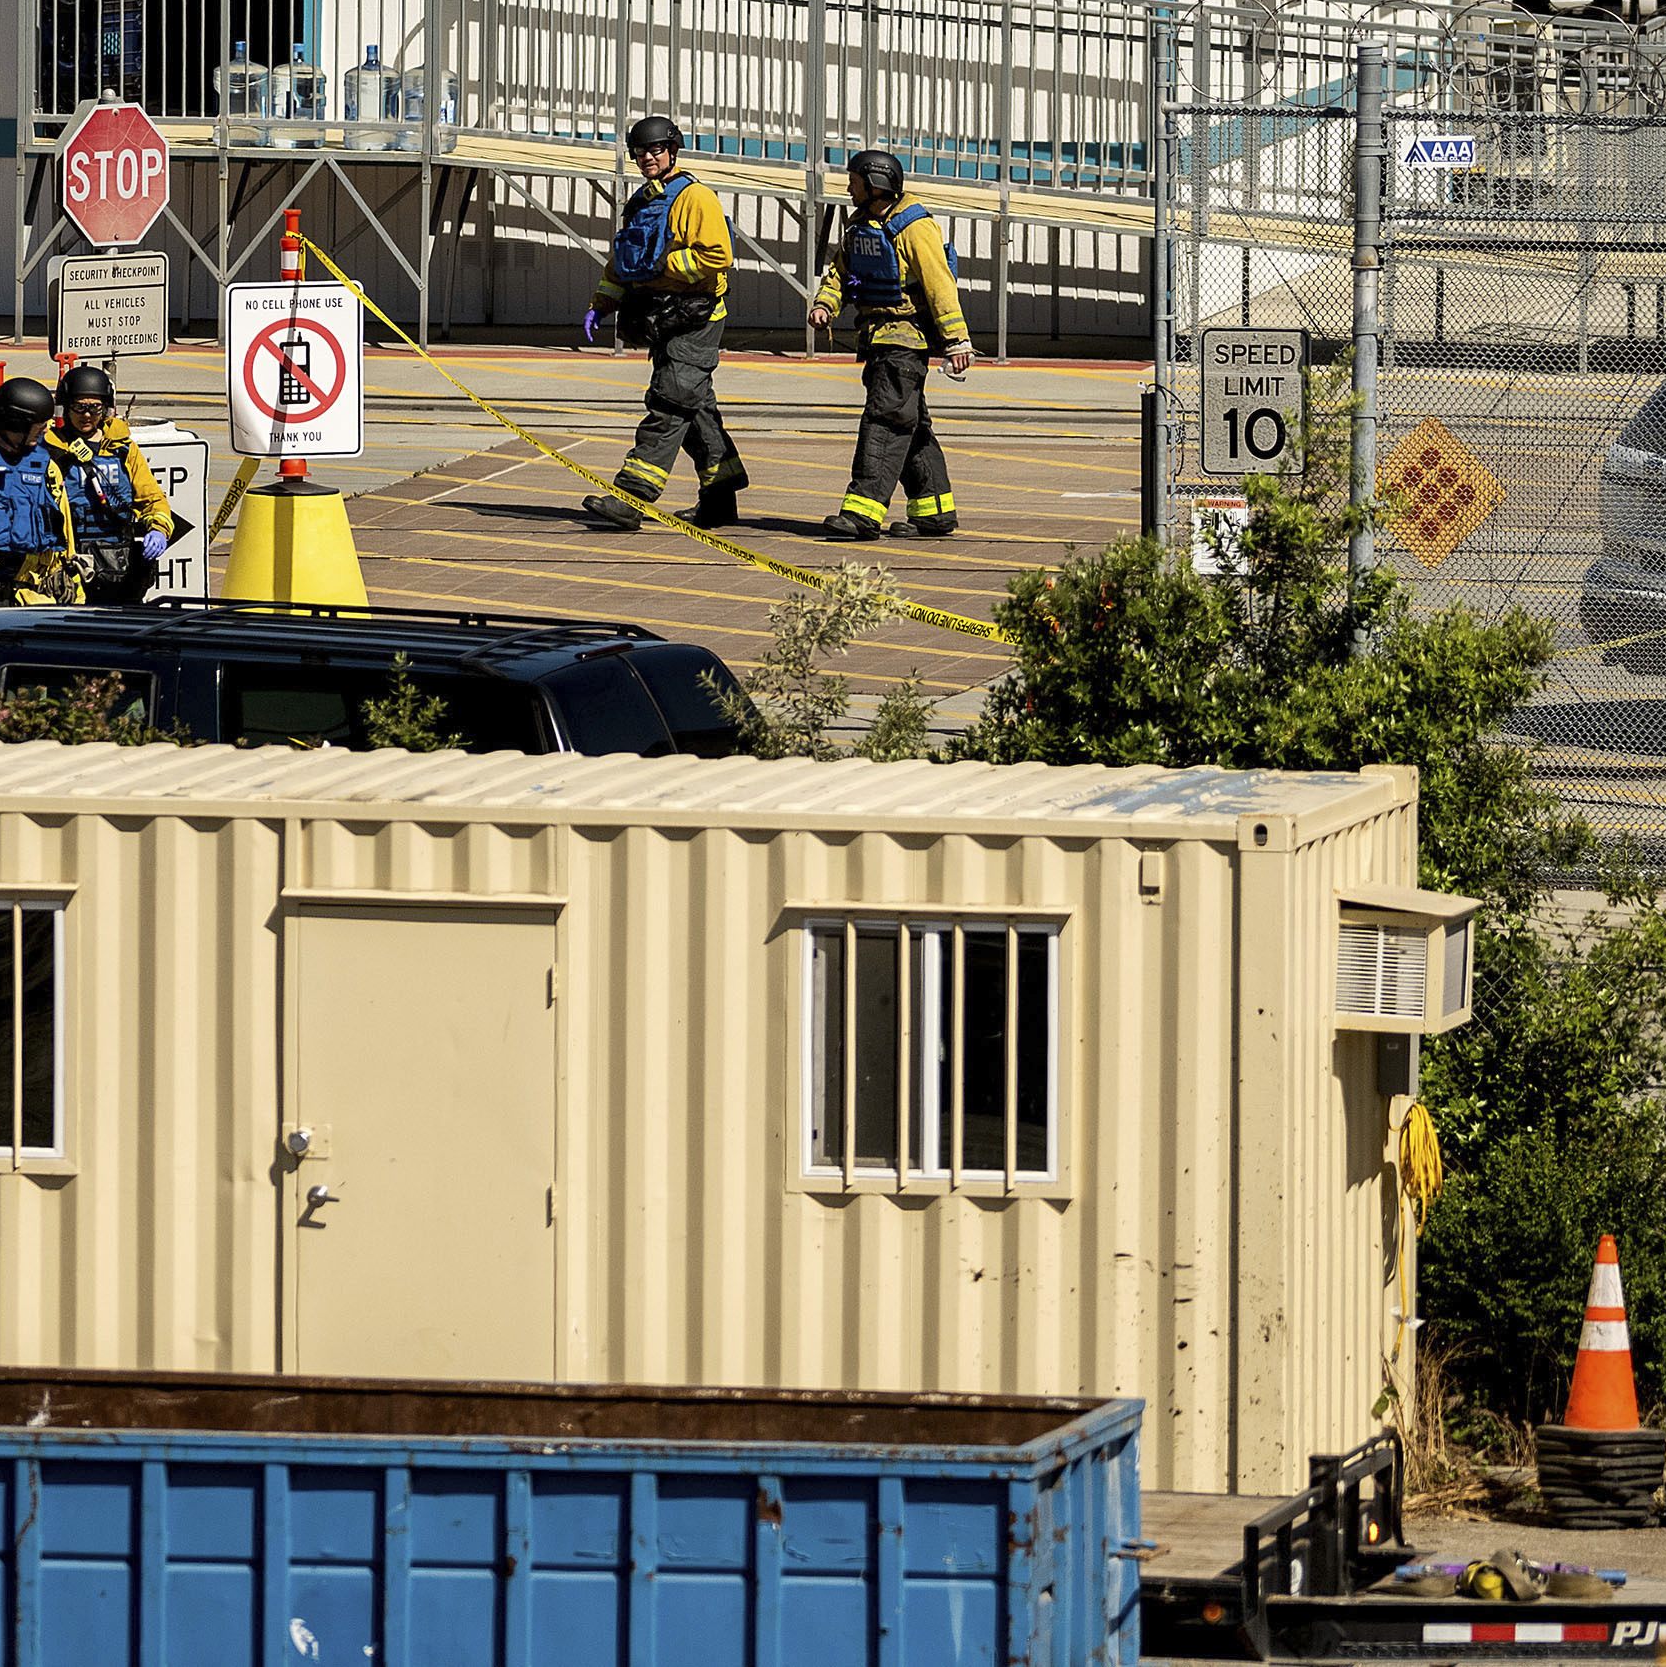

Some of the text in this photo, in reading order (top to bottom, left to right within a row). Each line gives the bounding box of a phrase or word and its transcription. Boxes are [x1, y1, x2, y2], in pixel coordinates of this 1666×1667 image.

[1431, 141, 1472, 157] AAA
[69, 148, 163, 202] STOP
[854, 237, 882, 257] FIRE
[69, 265, 161, 281] SECURITY CHECKPOINT
[84, 296, 146, 310] ALL VEHICLES
[245, 297, 343, 311] NO CELL PHONE USE
[87, 315, 141, 329] MUST STOP
[68, 332, 158, 348] BEFORE PROCEEDING
[1214, 344, 1296, 365] SPEED
[1224, 376, 1285, 397] LIMIT
[269, 431, 322, 444] THANK YOU
[1222, 407, 1285, 460] 10
[1207, 499, 1242, 508] WARNING
[1611, 1621, 1658, 1646] PJ
